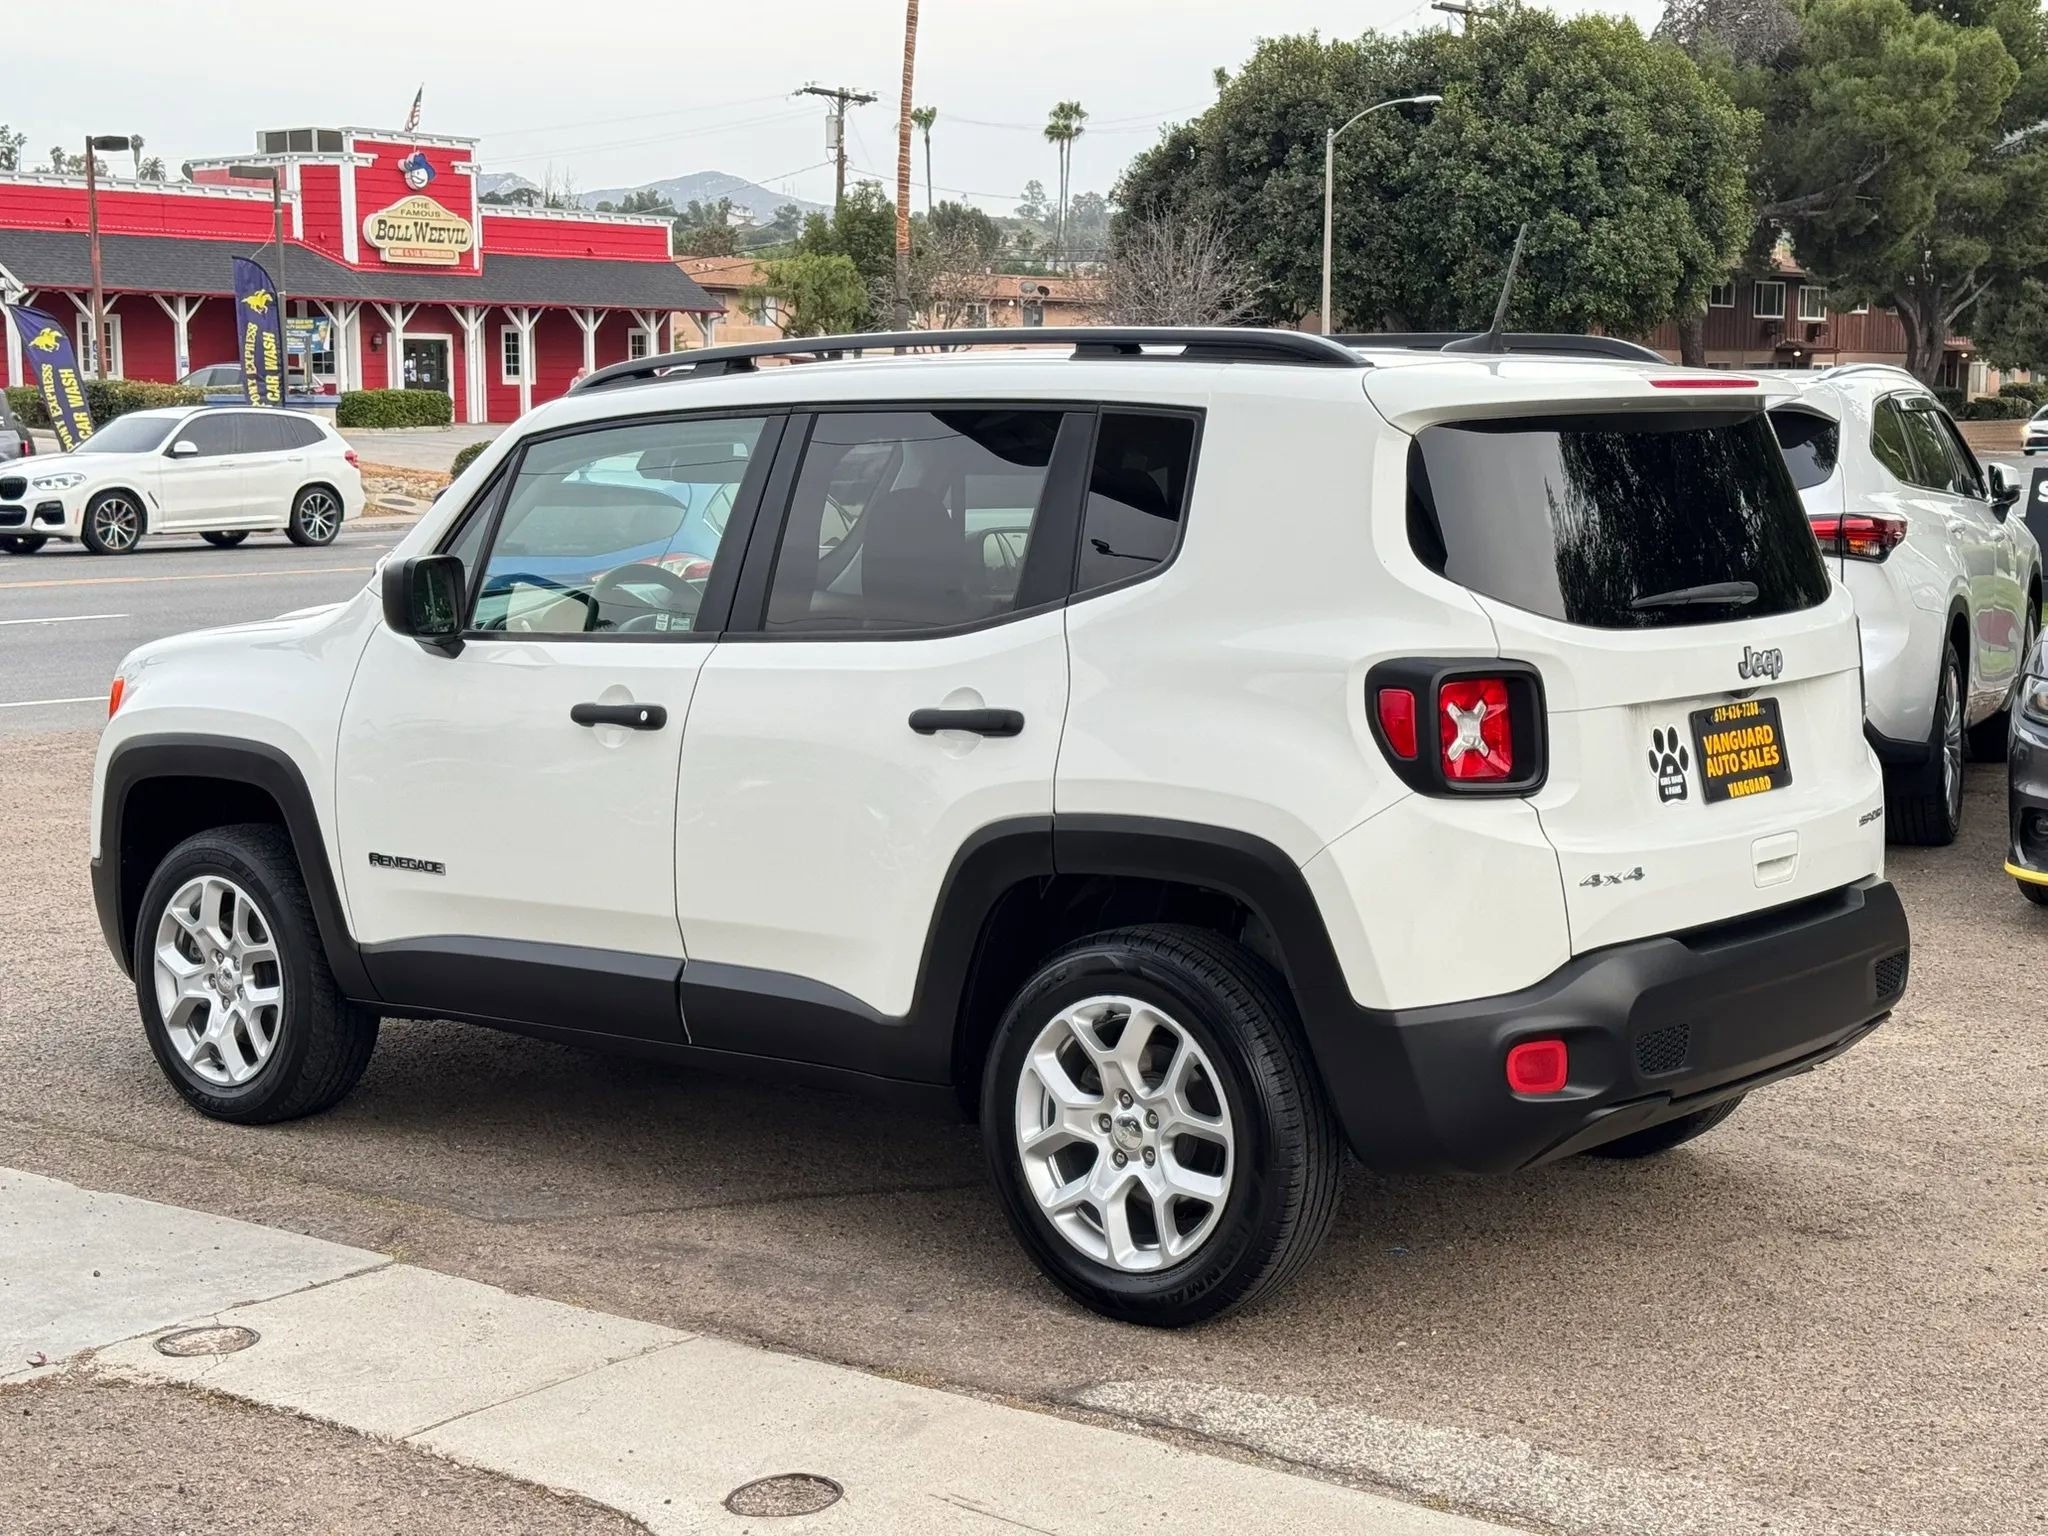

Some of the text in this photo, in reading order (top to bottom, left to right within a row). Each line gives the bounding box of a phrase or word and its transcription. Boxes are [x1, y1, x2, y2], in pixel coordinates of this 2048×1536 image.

[400, 209, 441, 217] FAMOUS
[411, 201, 430, 209] THE
[375, 219, 468, 245] BOLL WEEVIL
[244, 322, 259, 375] EXPRESS
[262, 332, 281, 401] CAR WASH
[41, 363, 63, 417] EXPRESS
[58, 368, 94, 440] CAR WASH
[1738, 646, 1783, 680] Jeep
[1703, 724, 1774, 755] VANGUARD
[1706, 745, 1780, 778] AUTO SALES
[1727, 775, 1772, 798] VANGUARD
[368, 851, 446, 876] RENEGADE
